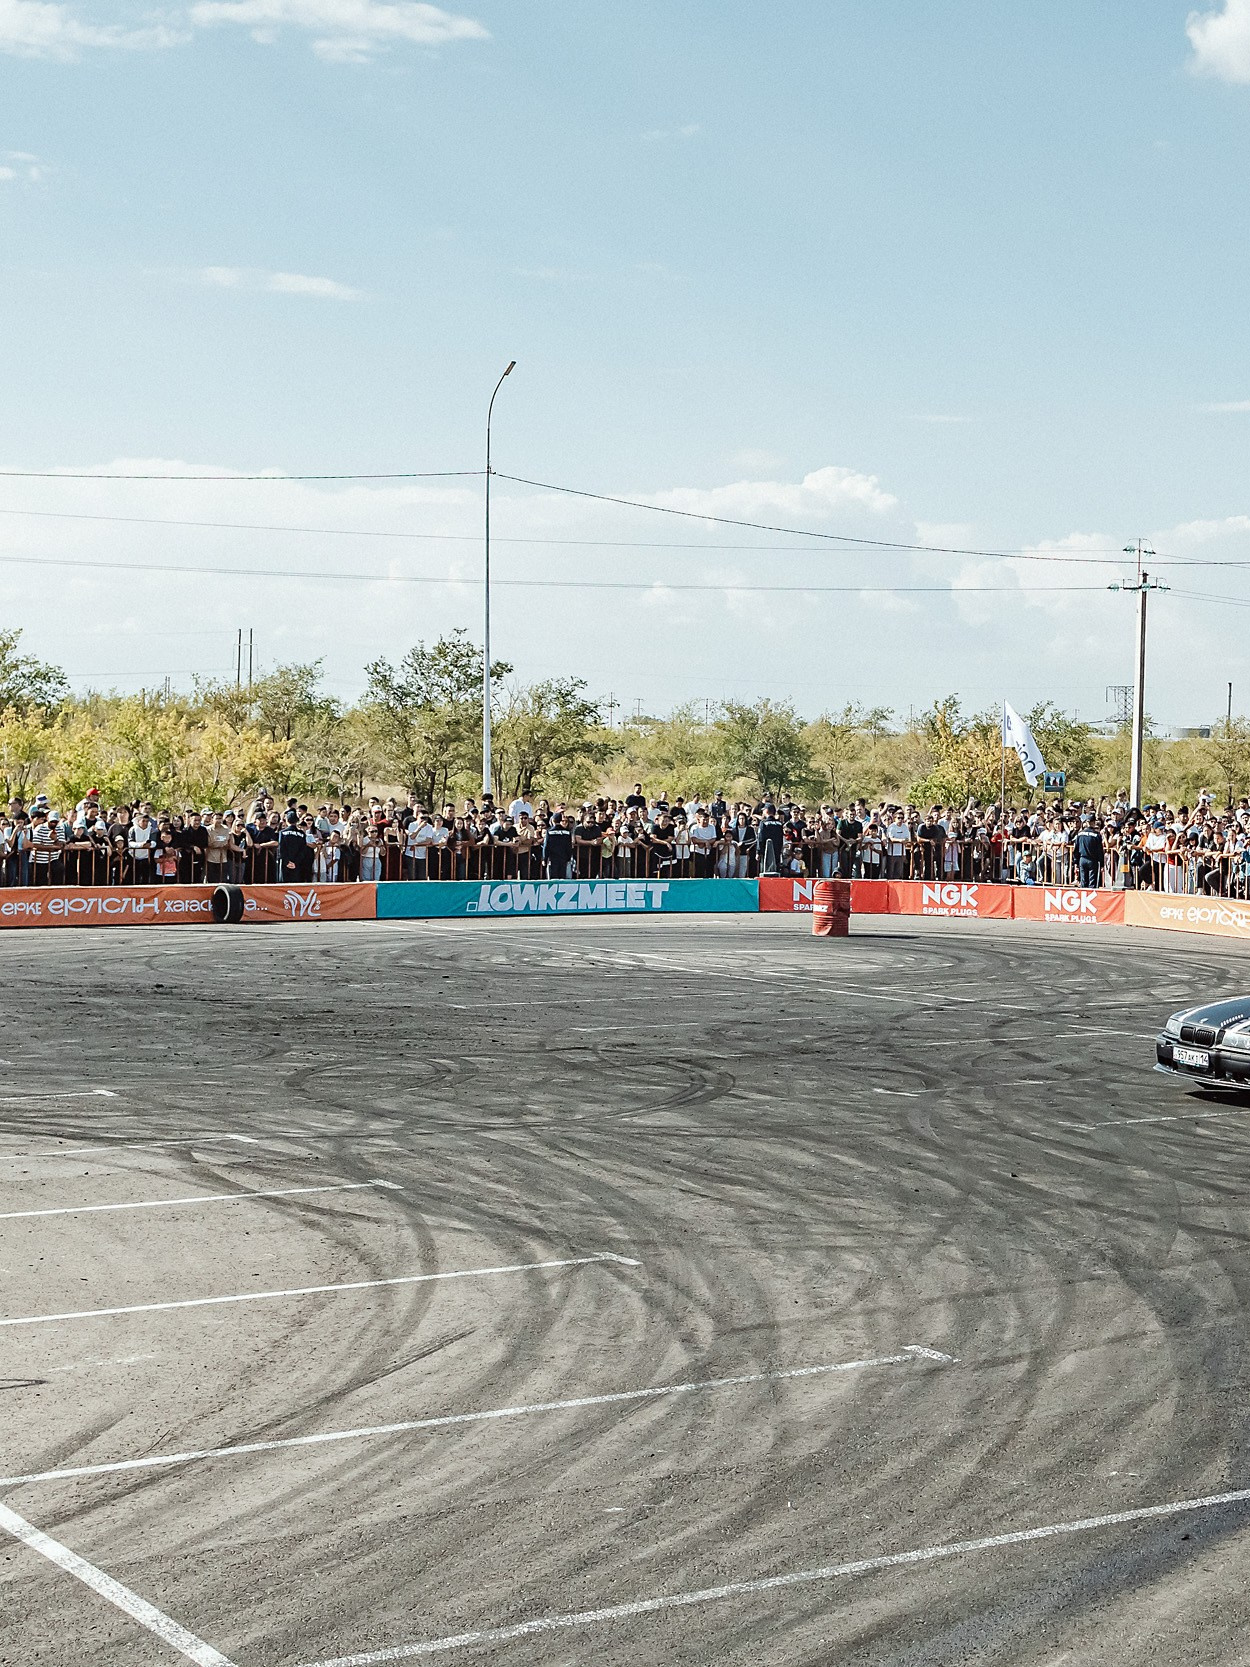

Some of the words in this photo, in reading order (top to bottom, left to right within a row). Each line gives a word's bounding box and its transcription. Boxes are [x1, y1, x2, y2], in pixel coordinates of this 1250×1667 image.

[478, 882, 670, 912] LOWKZMEET
[922, 883, 979, 908] NGK
[1044, 889, 1098, 914] NGK
[793, 903, 814, 911] SPA
[922, 906, 949, 916] SPARK
[950, 907, 978, 917] PLUGS
[1044, 913, 1070, 922] SPARK
[1071, 914, 1097, 923] PLUGS
